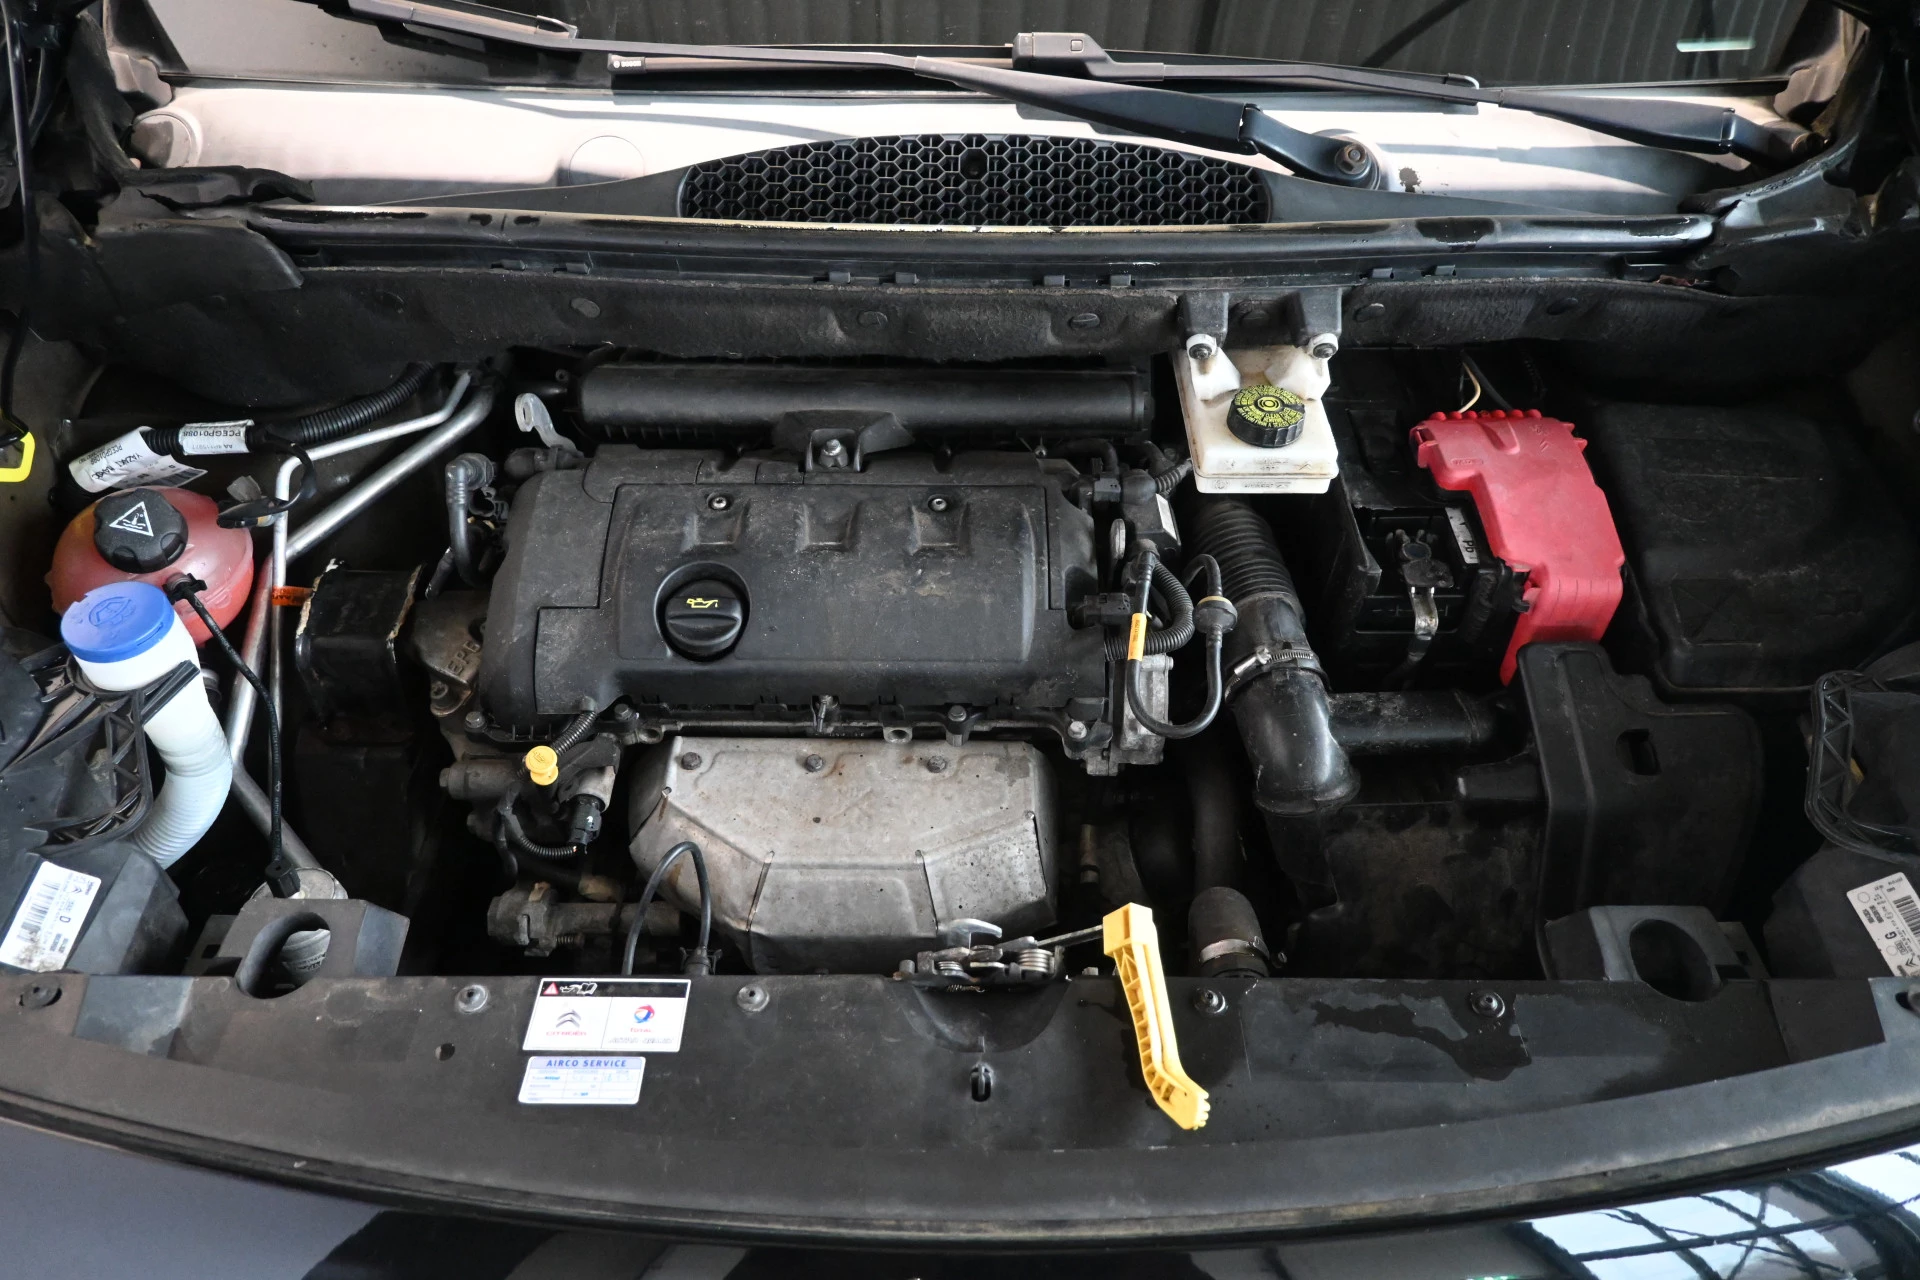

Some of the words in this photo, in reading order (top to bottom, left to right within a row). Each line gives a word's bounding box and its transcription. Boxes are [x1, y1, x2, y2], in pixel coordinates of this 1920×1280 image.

[1462, 540, 1477, 553] Pb
[1884, 931, 1897, 940] G
[546, 1059, 579, 1067] AIRCO
[583, 1059, 627, 1067] SERVICE
